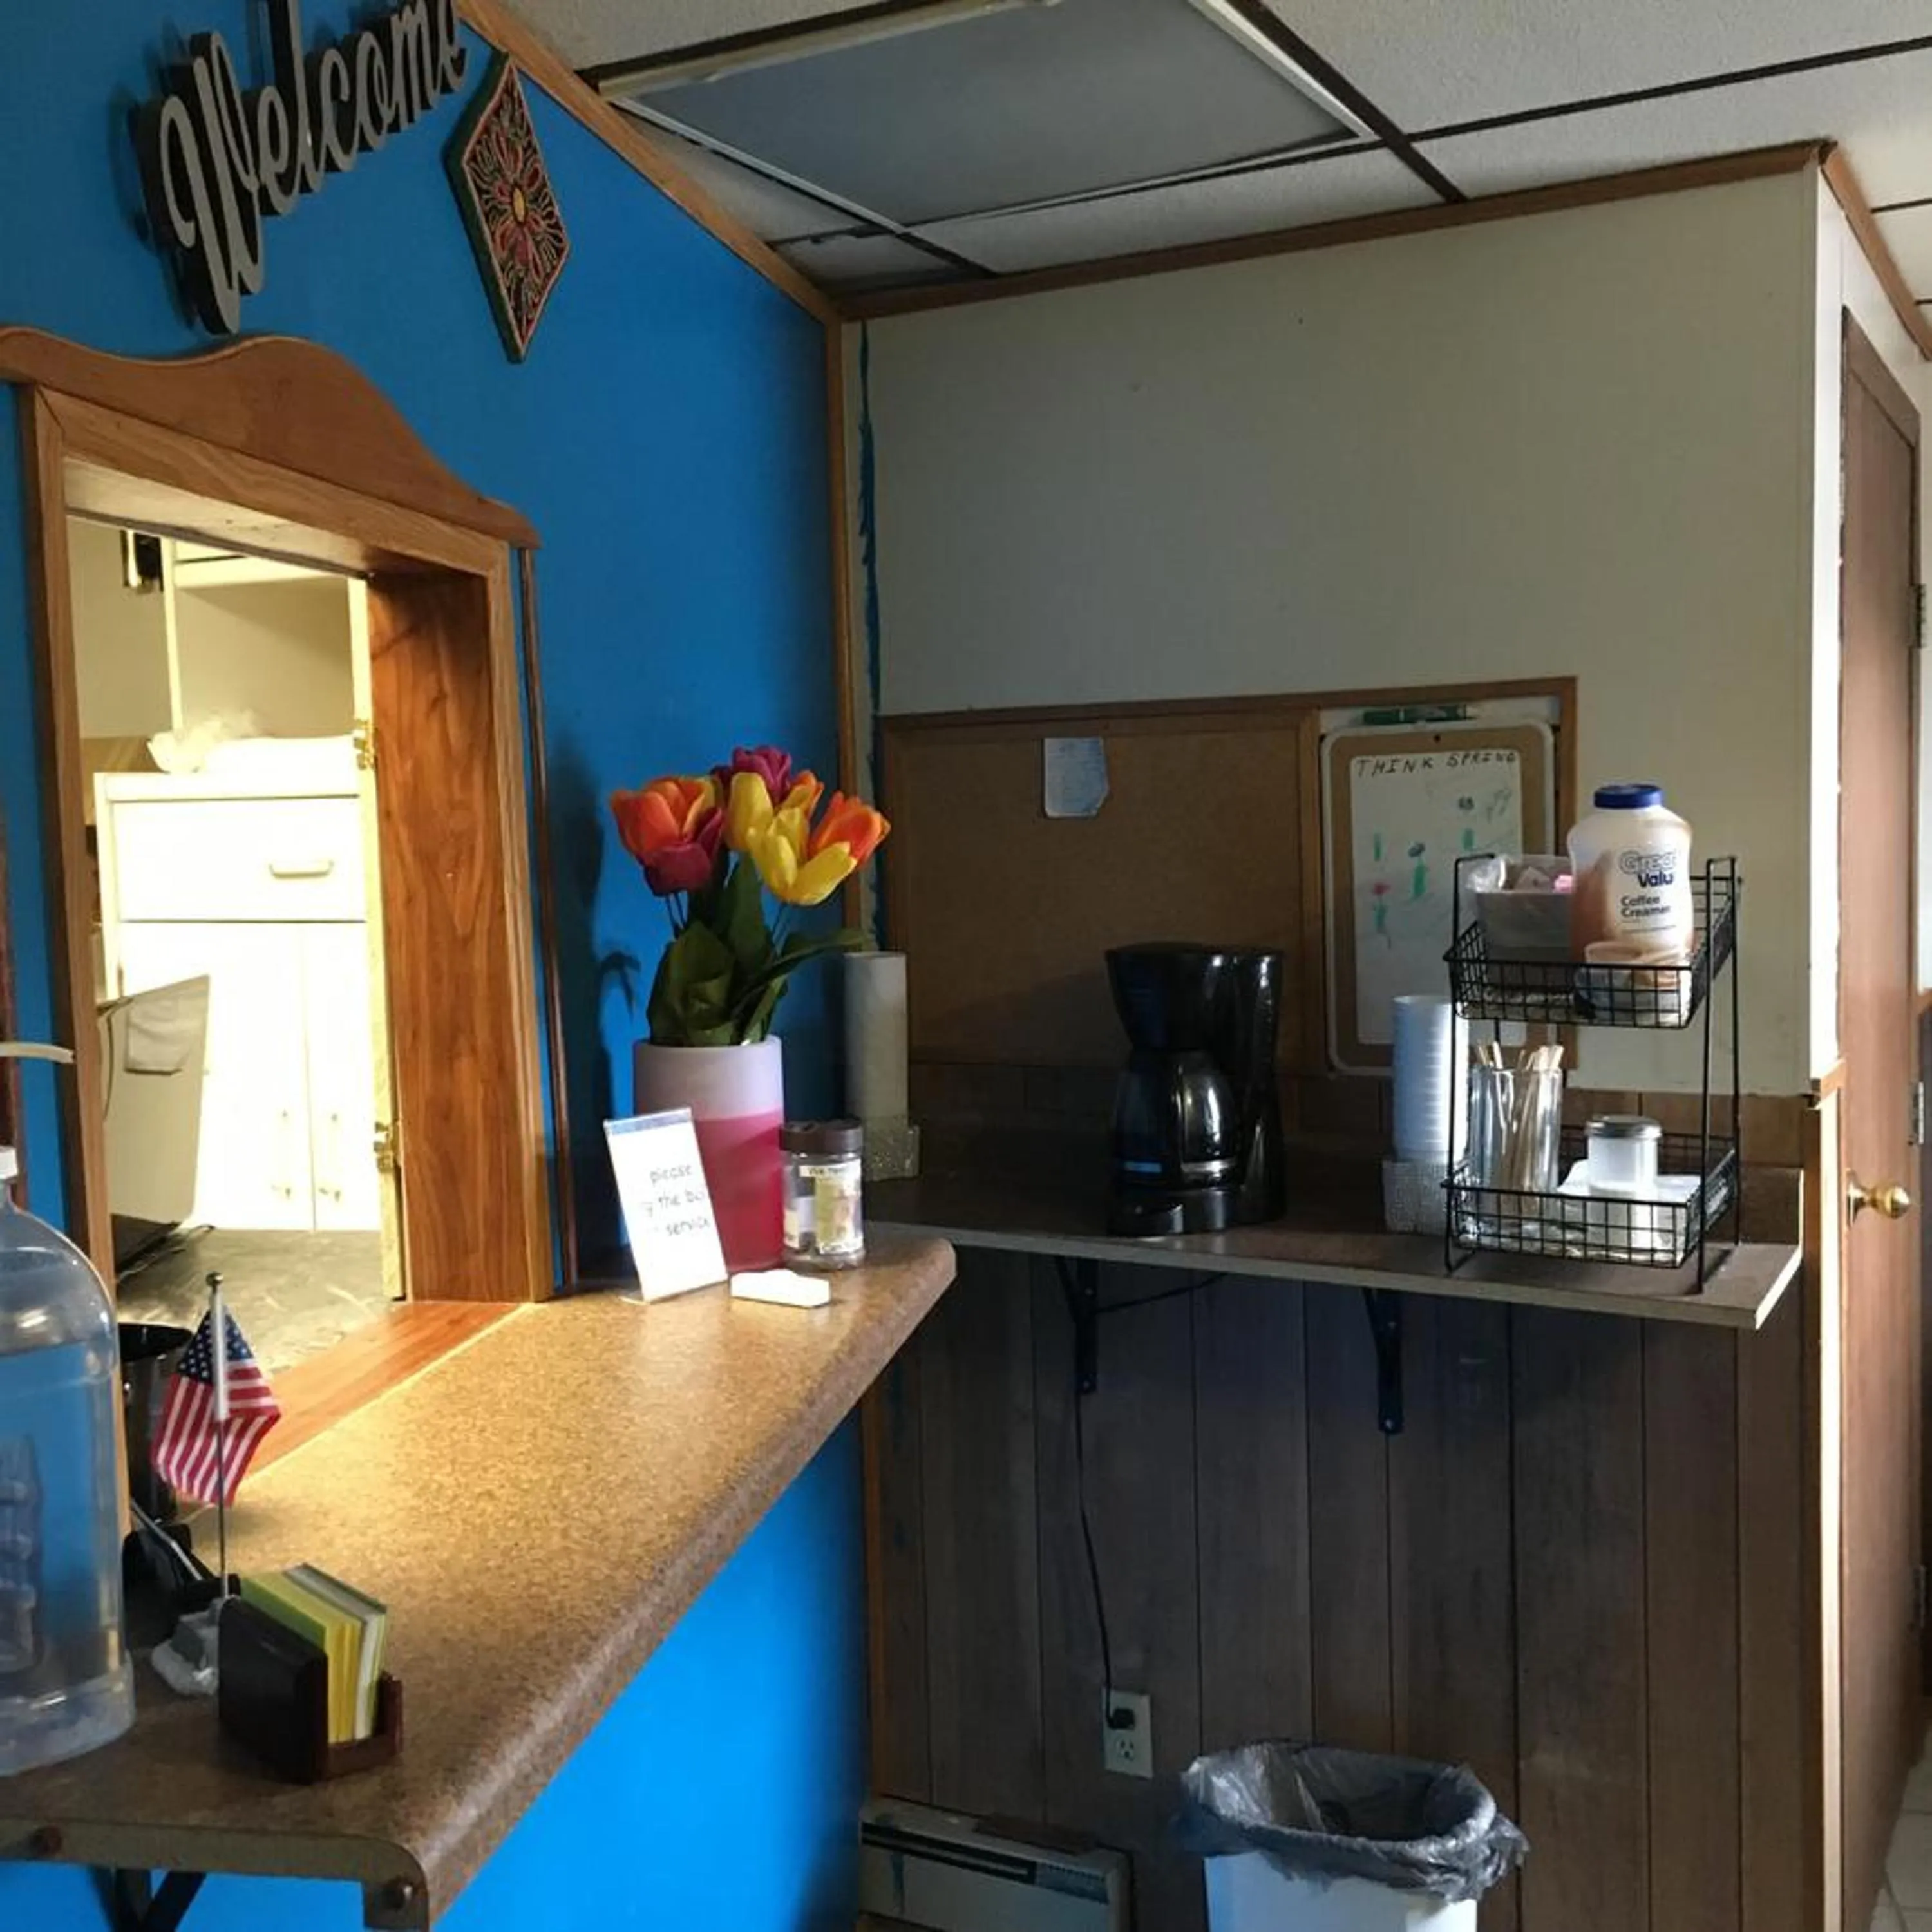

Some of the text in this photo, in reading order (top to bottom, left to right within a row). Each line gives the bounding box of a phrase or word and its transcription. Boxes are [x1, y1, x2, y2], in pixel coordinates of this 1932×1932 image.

[1355, 752, 1517, 777] THINK SPRING
[1619, 850, 1676, 875] Grea
[1637, 870, 1674, 887] Valu
[1620, 895, 1660, 906] Coffee
